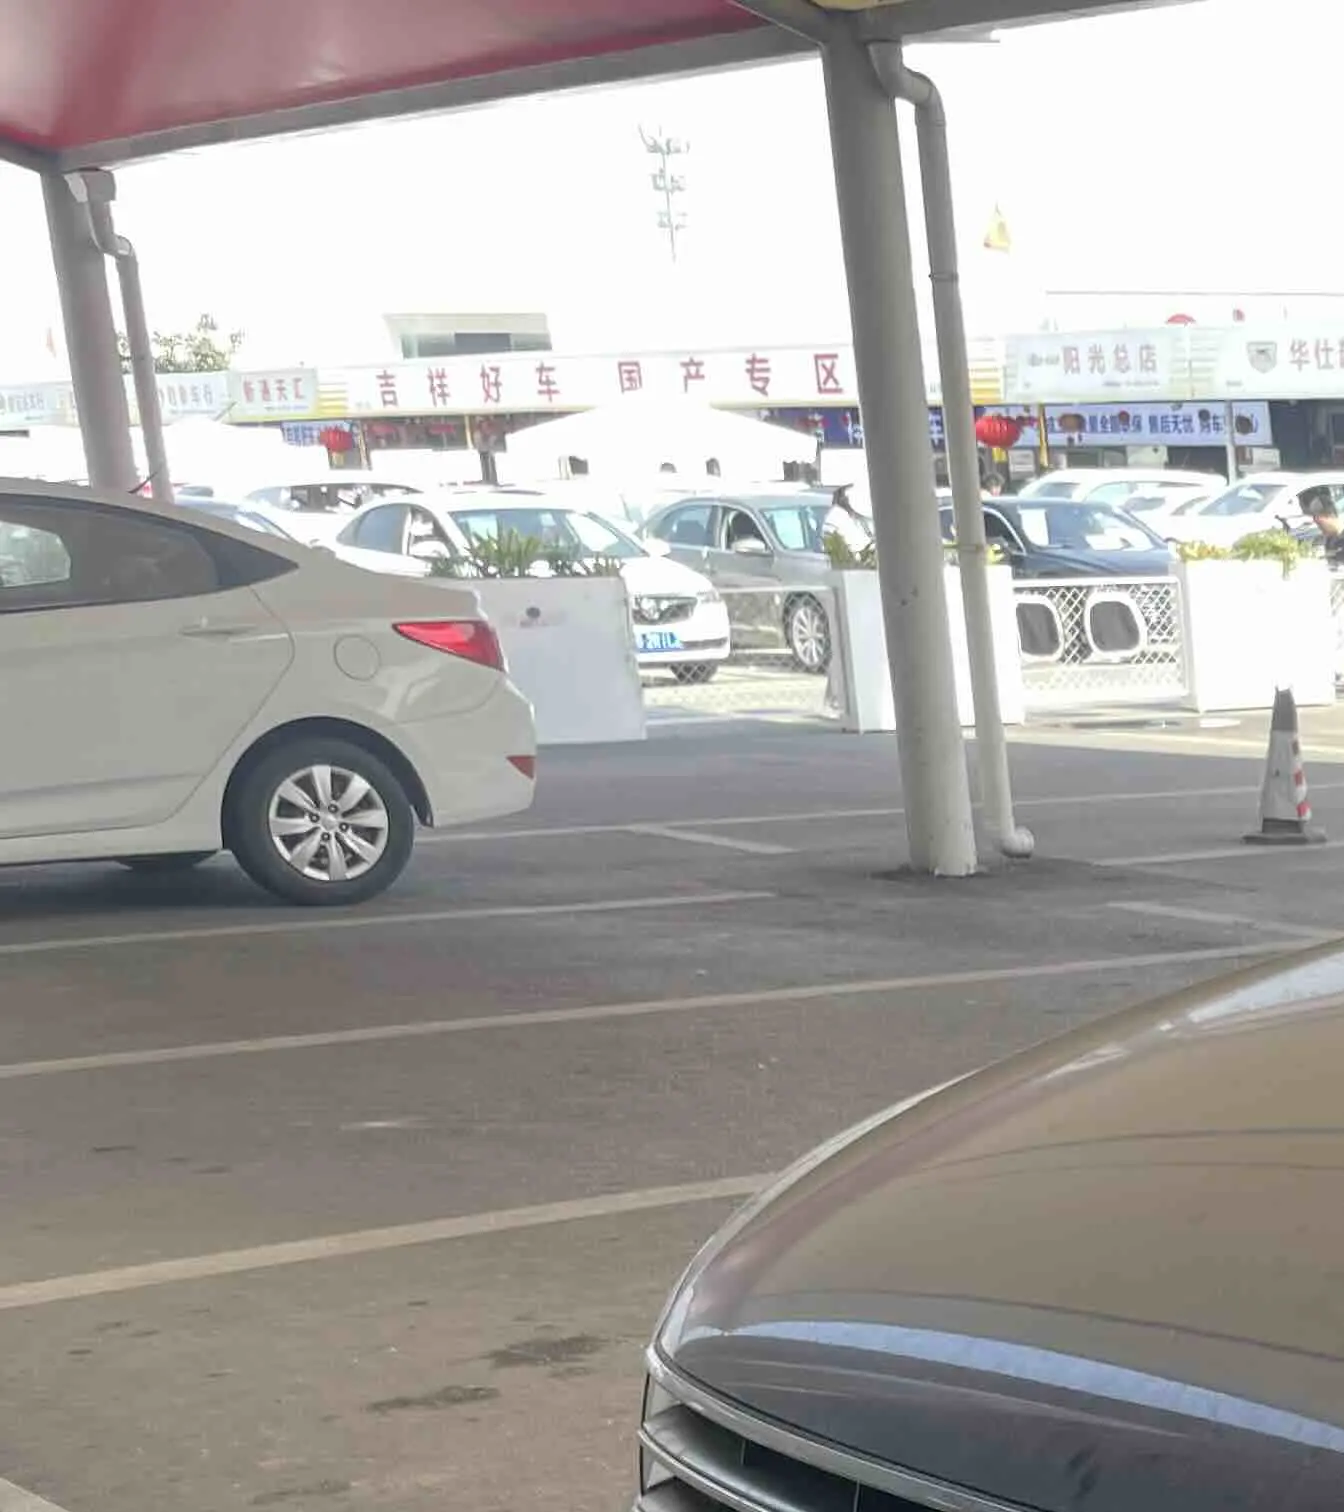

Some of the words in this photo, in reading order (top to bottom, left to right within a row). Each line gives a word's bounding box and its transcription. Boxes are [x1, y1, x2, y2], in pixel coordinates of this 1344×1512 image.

[376, 361, 561, 408] 吉祥好车
[616, 352, 845, 395] 国产专区
[1062, 343, 1157, 375] 阳光总店
